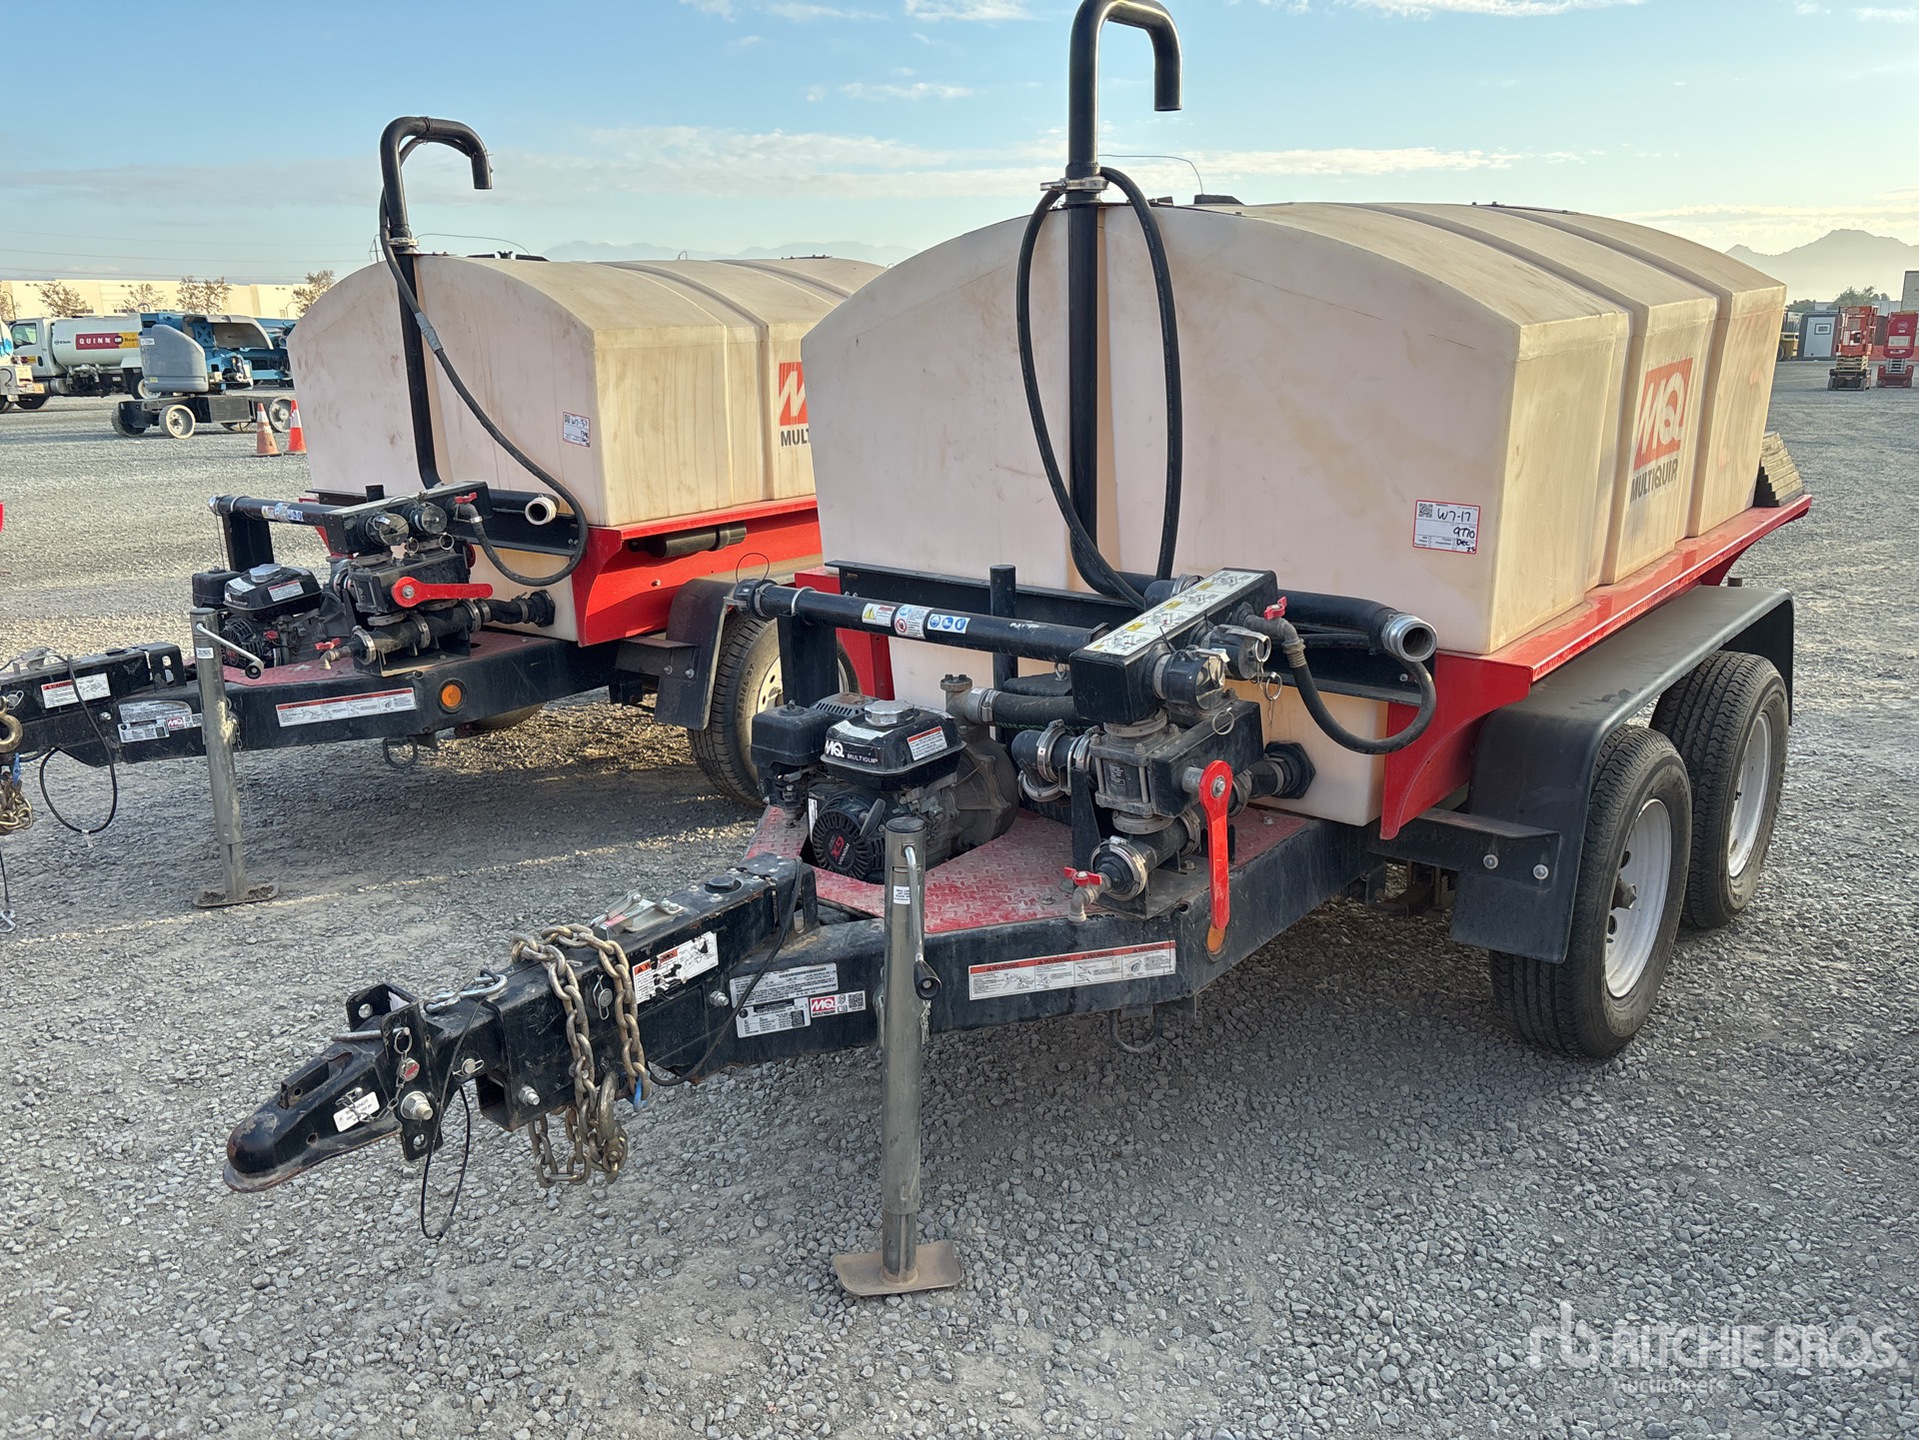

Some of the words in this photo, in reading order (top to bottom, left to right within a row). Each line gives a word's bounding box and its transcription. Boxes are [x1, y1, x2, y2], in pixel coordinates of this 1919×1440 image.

[1637, 371, 1685, 455] MQ
[1630, 458, 1678, 504] MULTIQUIP
[1437, 508, 1471, 522] W7-17
[825, 739, 845, 758] MQ
[847, 753, 878, 764] MULTIQUIP
[812, 998, 835, 1011] MQ
